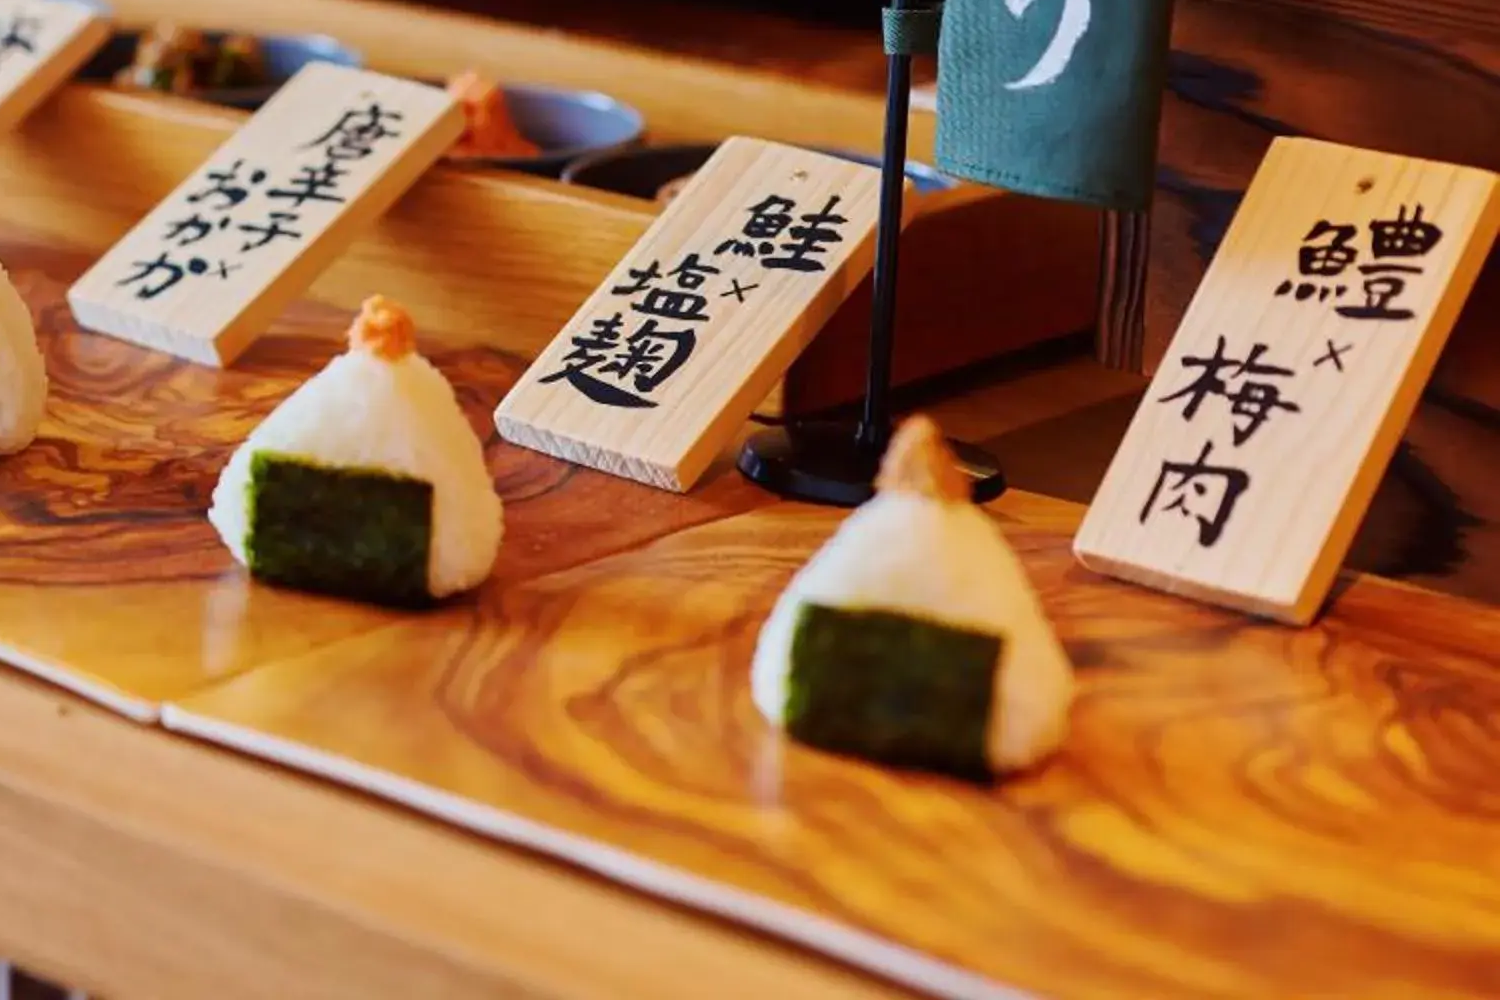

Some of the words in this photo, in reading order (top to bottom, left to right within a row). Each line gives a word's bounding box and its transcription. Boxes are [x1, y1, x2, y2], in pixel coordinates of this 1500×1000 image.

[114, 159, 266, 300] おかか
[538, 253, 720, 408] 塩麹
[1139, 335, 1302, 548] 梅肉
